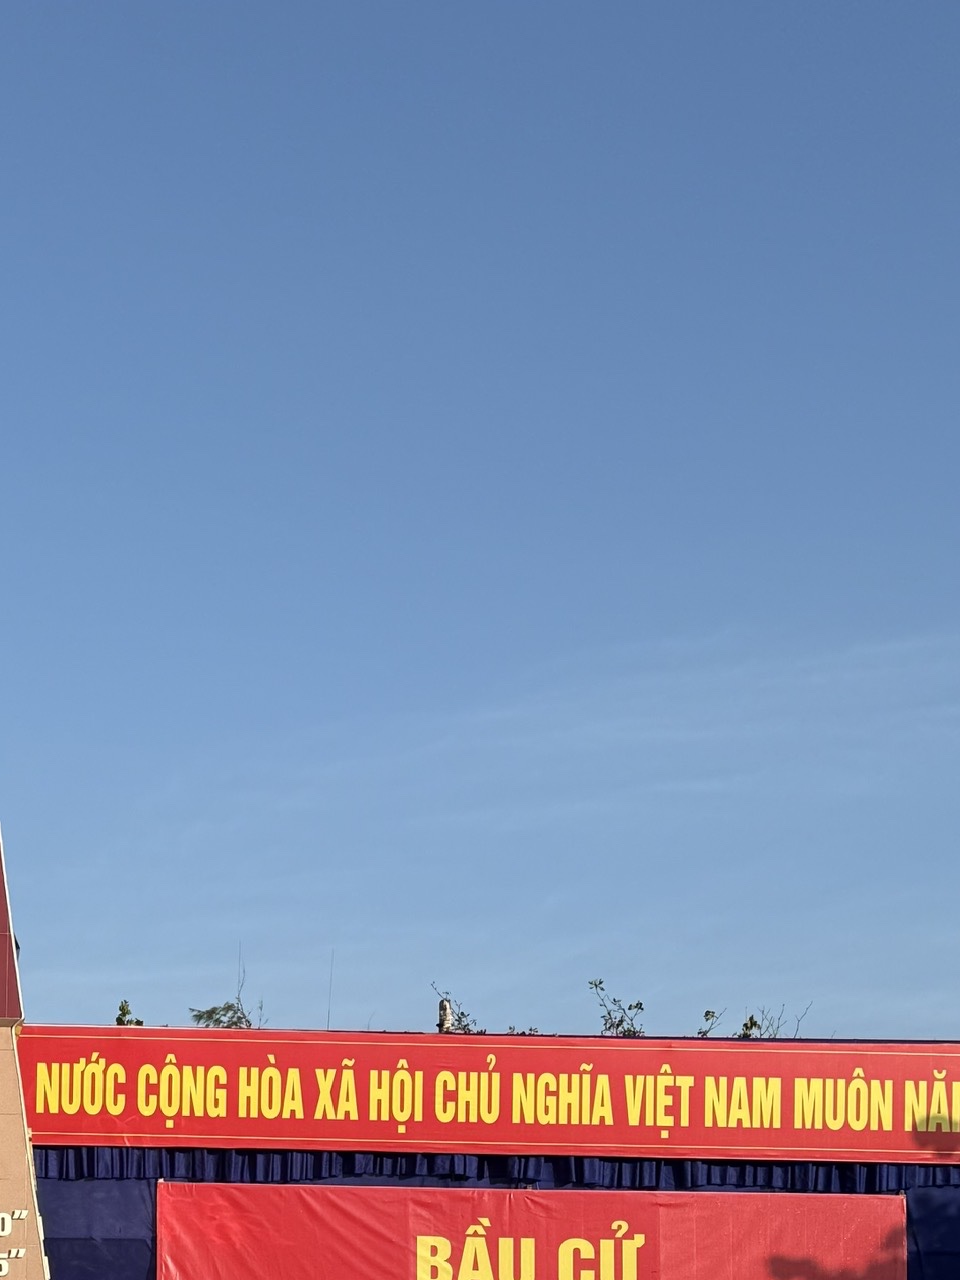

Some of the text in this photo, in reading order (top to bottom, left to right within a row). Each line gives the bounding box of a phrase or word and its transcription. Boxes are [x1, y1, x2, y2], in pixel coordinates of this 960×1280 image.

[36, 1052, 126, 1116] NƯỚC
[137, 1053, 227, 1129] CỘNG
[238, 1054, 304, 1119] HÒA
[314, 1058, 359, 1121] XÃ
[369, 1059, 424, 1134] HỘI
[435, 1054, 501, 1124] CHỦ
[512, 1063, 613, 1126] NGHĨA
[624, 1063, 695, 1139] VIỆT
[704, 1076, 781, 1130] NAM
[793, 1067, 893, 1132] MUÔN
